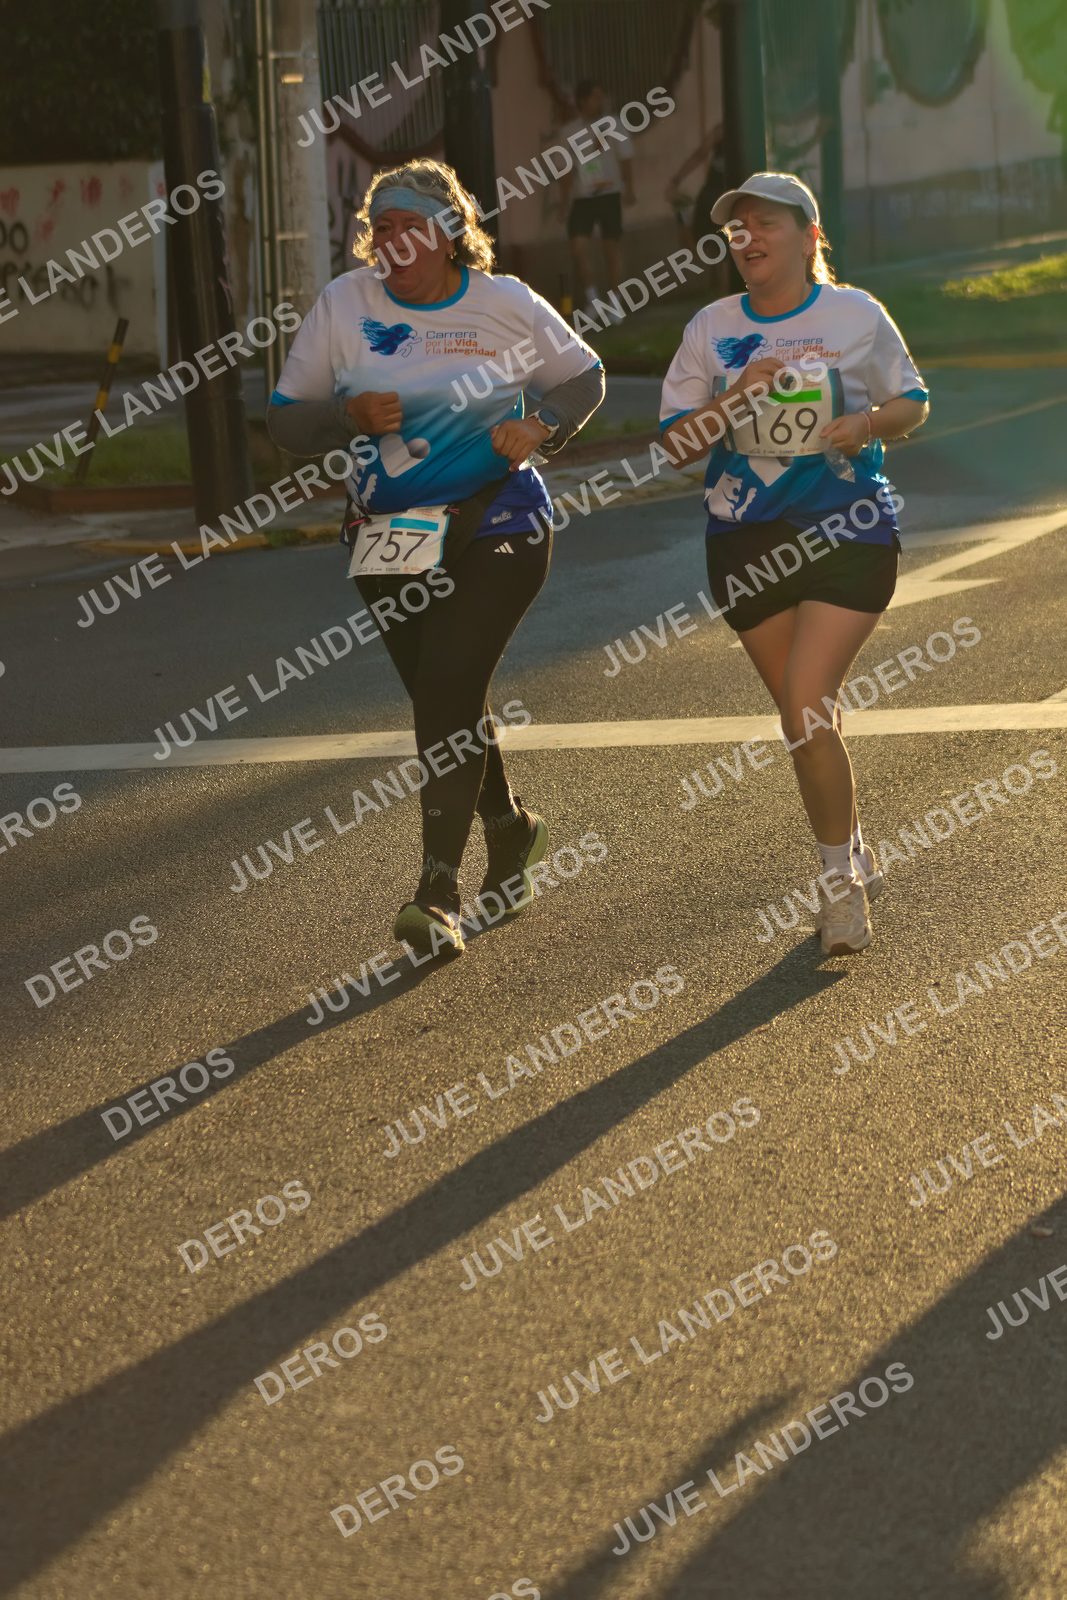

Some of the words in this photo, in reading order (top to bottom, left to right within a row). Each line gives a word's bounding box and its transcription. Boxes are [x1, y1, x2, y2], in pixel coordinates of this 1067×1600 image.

[426, 331, 477, 339] Carrera
[425, 340, 441, 348] por
[444, 339, 453, 347] la
[455, 339, 478, 347] Vida
[776, 337, 823, 347] Carrera
[444, 347, 497, 357] Integridad
[802, 344, 824, 352] Vida
[747, 407, 818, 445] 169
[361, 531, 430, 564] 757
